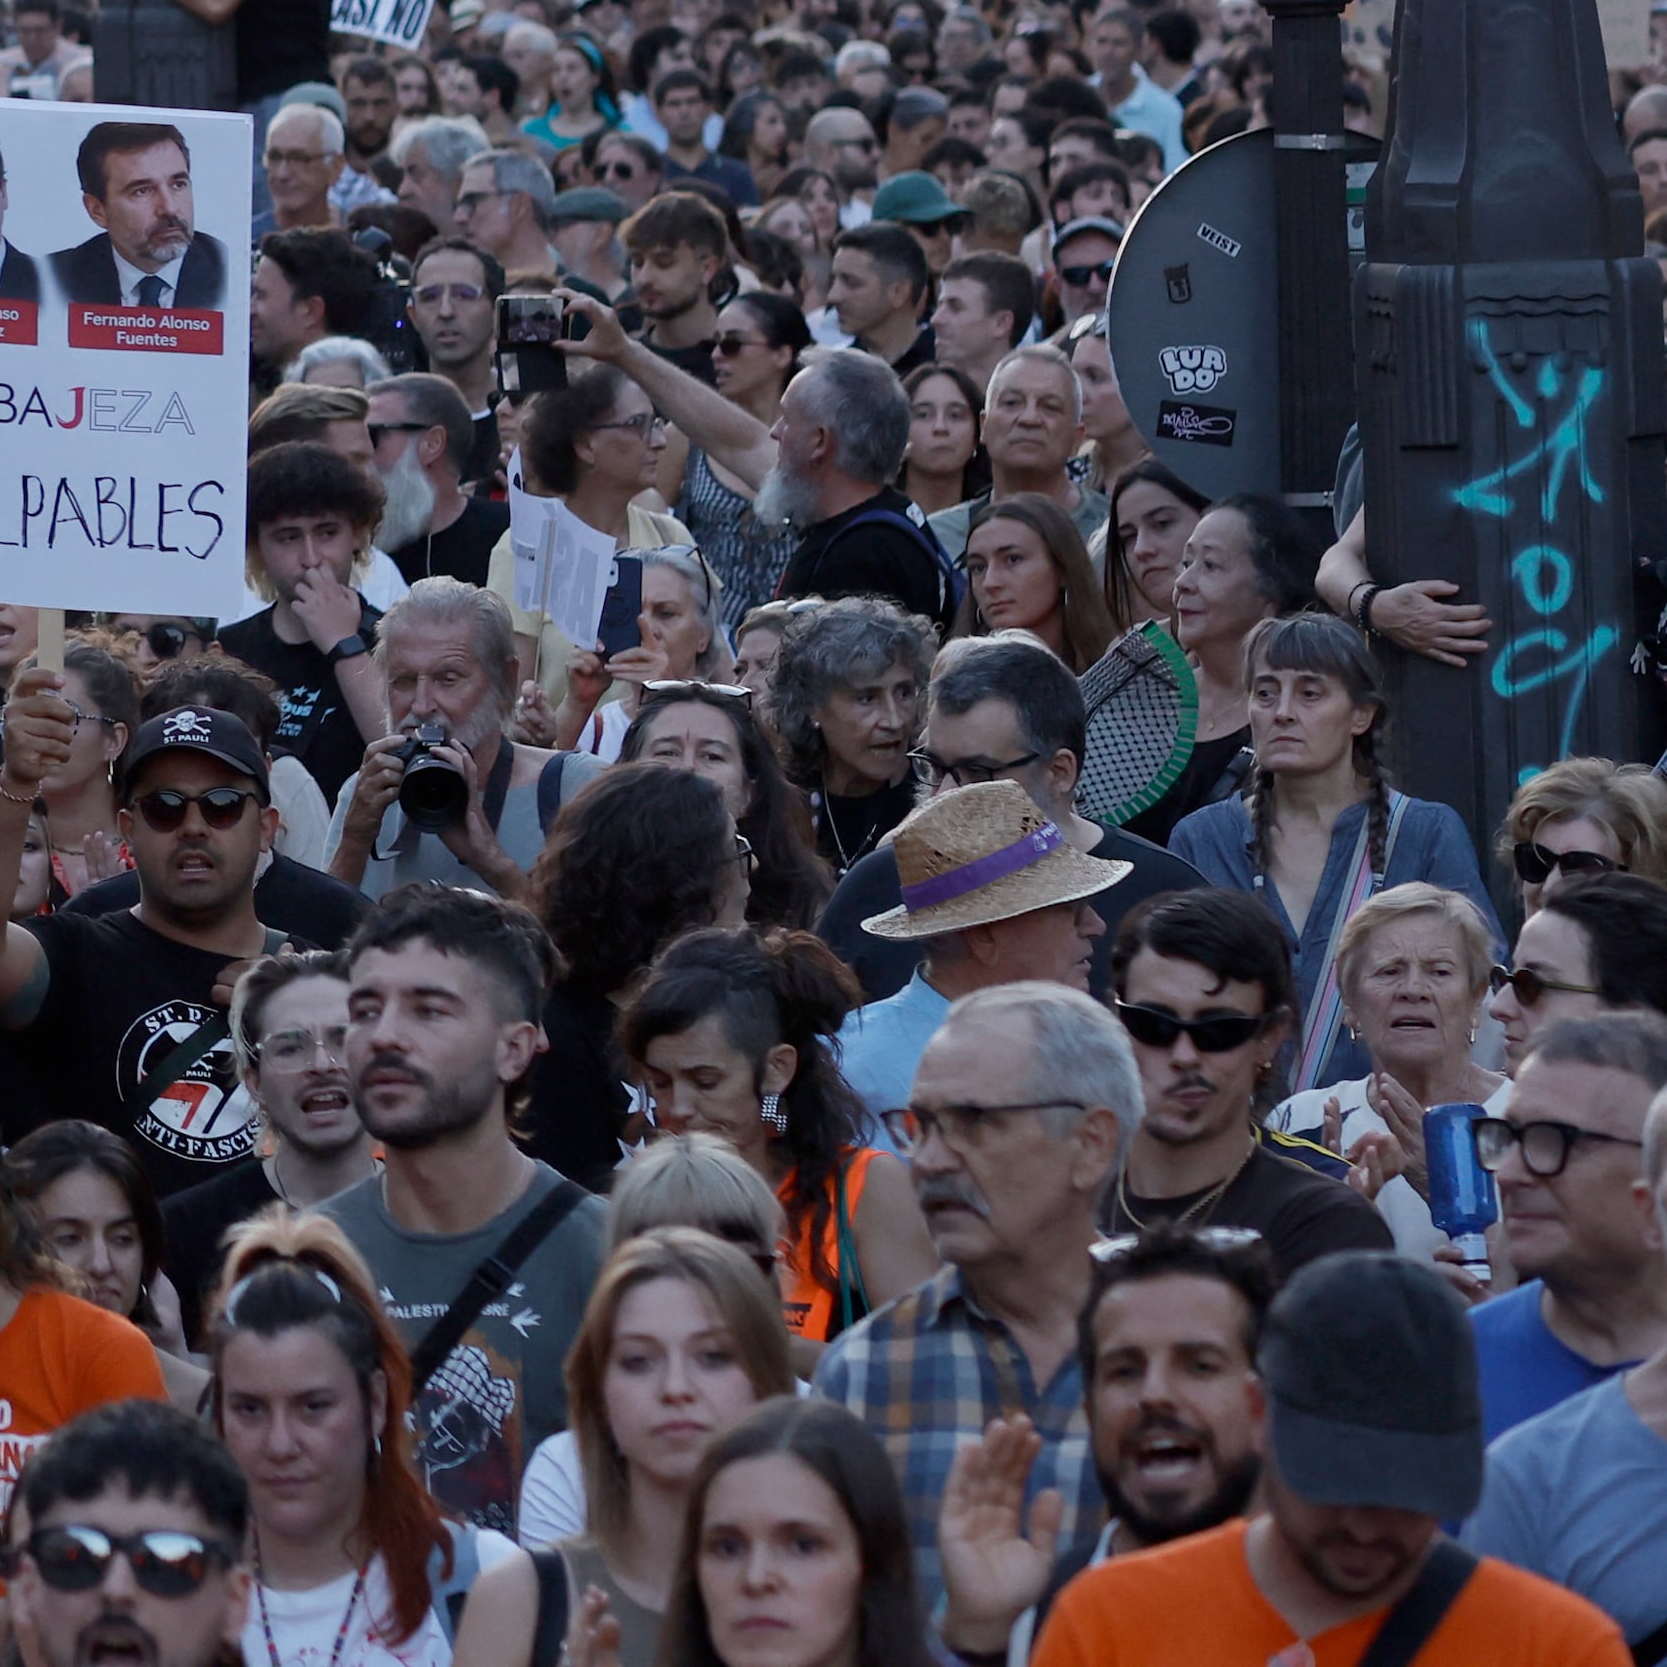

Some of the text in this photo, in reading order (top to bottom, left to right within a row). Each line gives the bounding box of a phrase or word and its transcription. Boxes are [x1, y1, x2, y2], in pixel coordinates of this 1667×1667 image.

[1199, 226, 1239, 255] VEIST
[83, 312, 211, 332] Fernando Alonso
[116, 331, 179, 349] Fuentes
[163, 735, 209, 745] ST. PAULI
[144, 1007, 183, 1034] ST.
